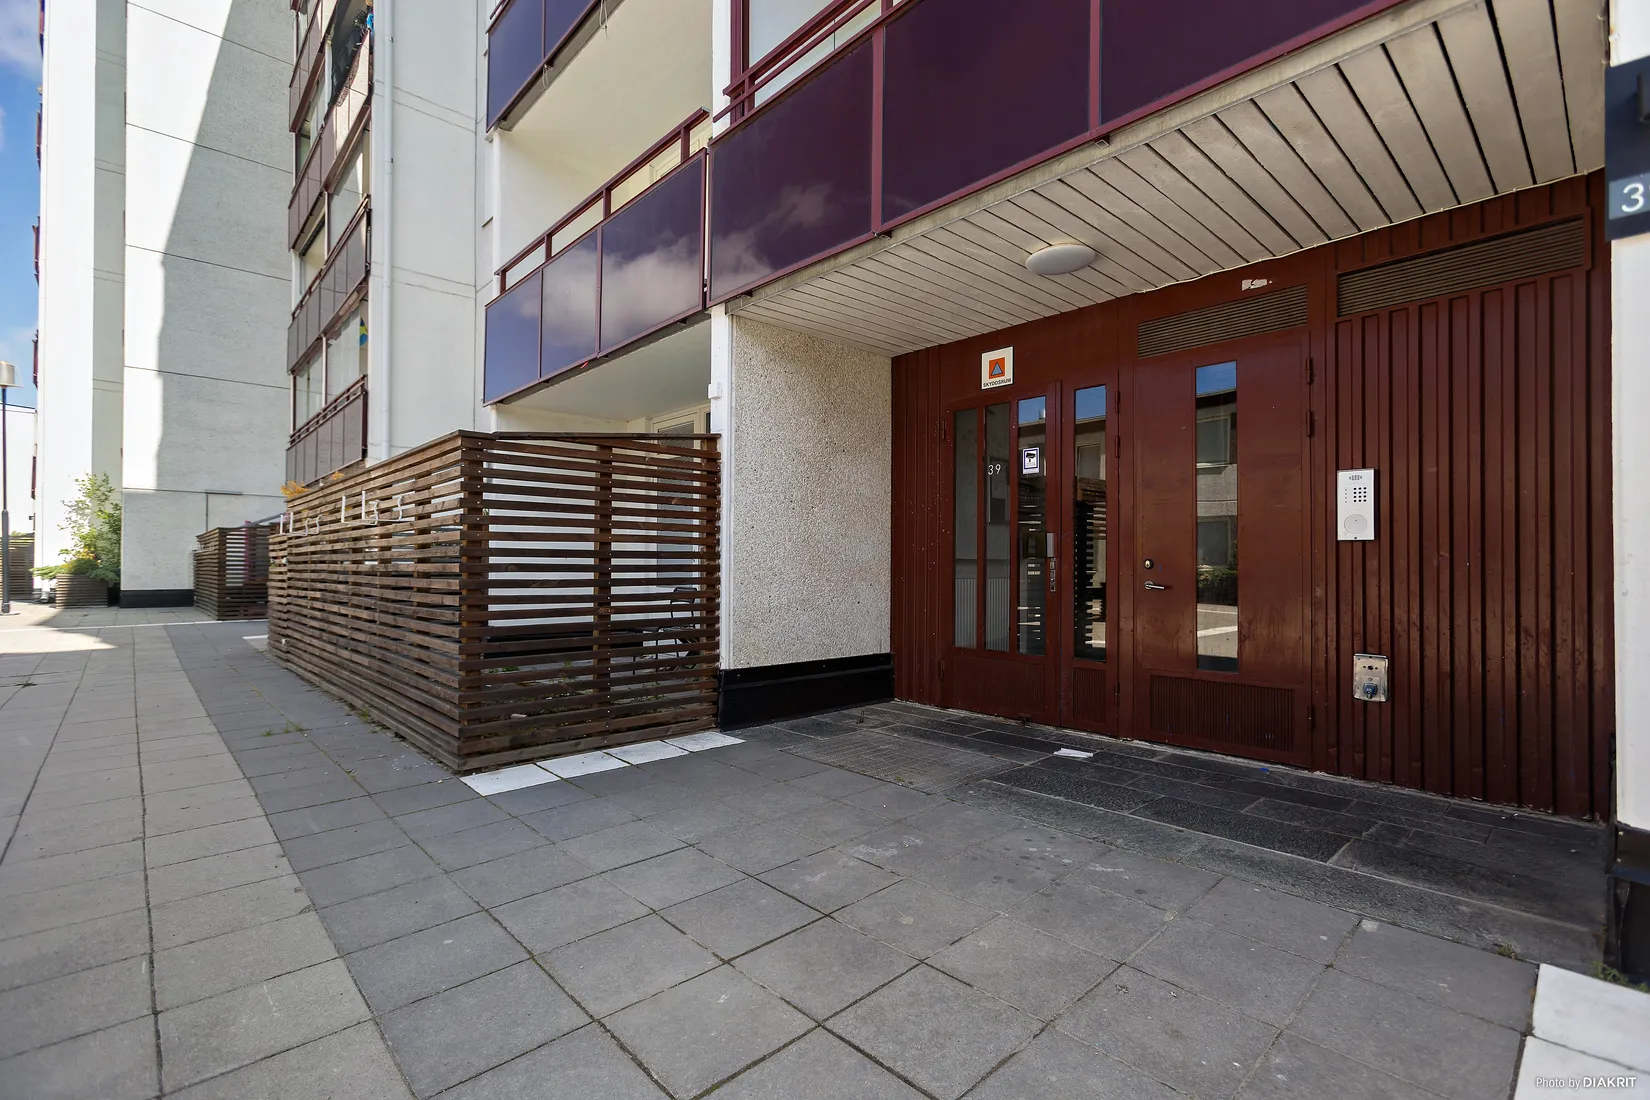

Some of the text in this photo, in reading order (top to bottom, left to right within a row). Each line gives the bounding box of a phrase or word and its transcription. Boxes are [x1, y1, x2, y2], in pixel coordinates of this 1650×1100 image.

[1621, 182, 1650, 213] 3
[983, 377, 1012, 387] SKYDDSRUM
[987, 463, 1002, 475] 39
